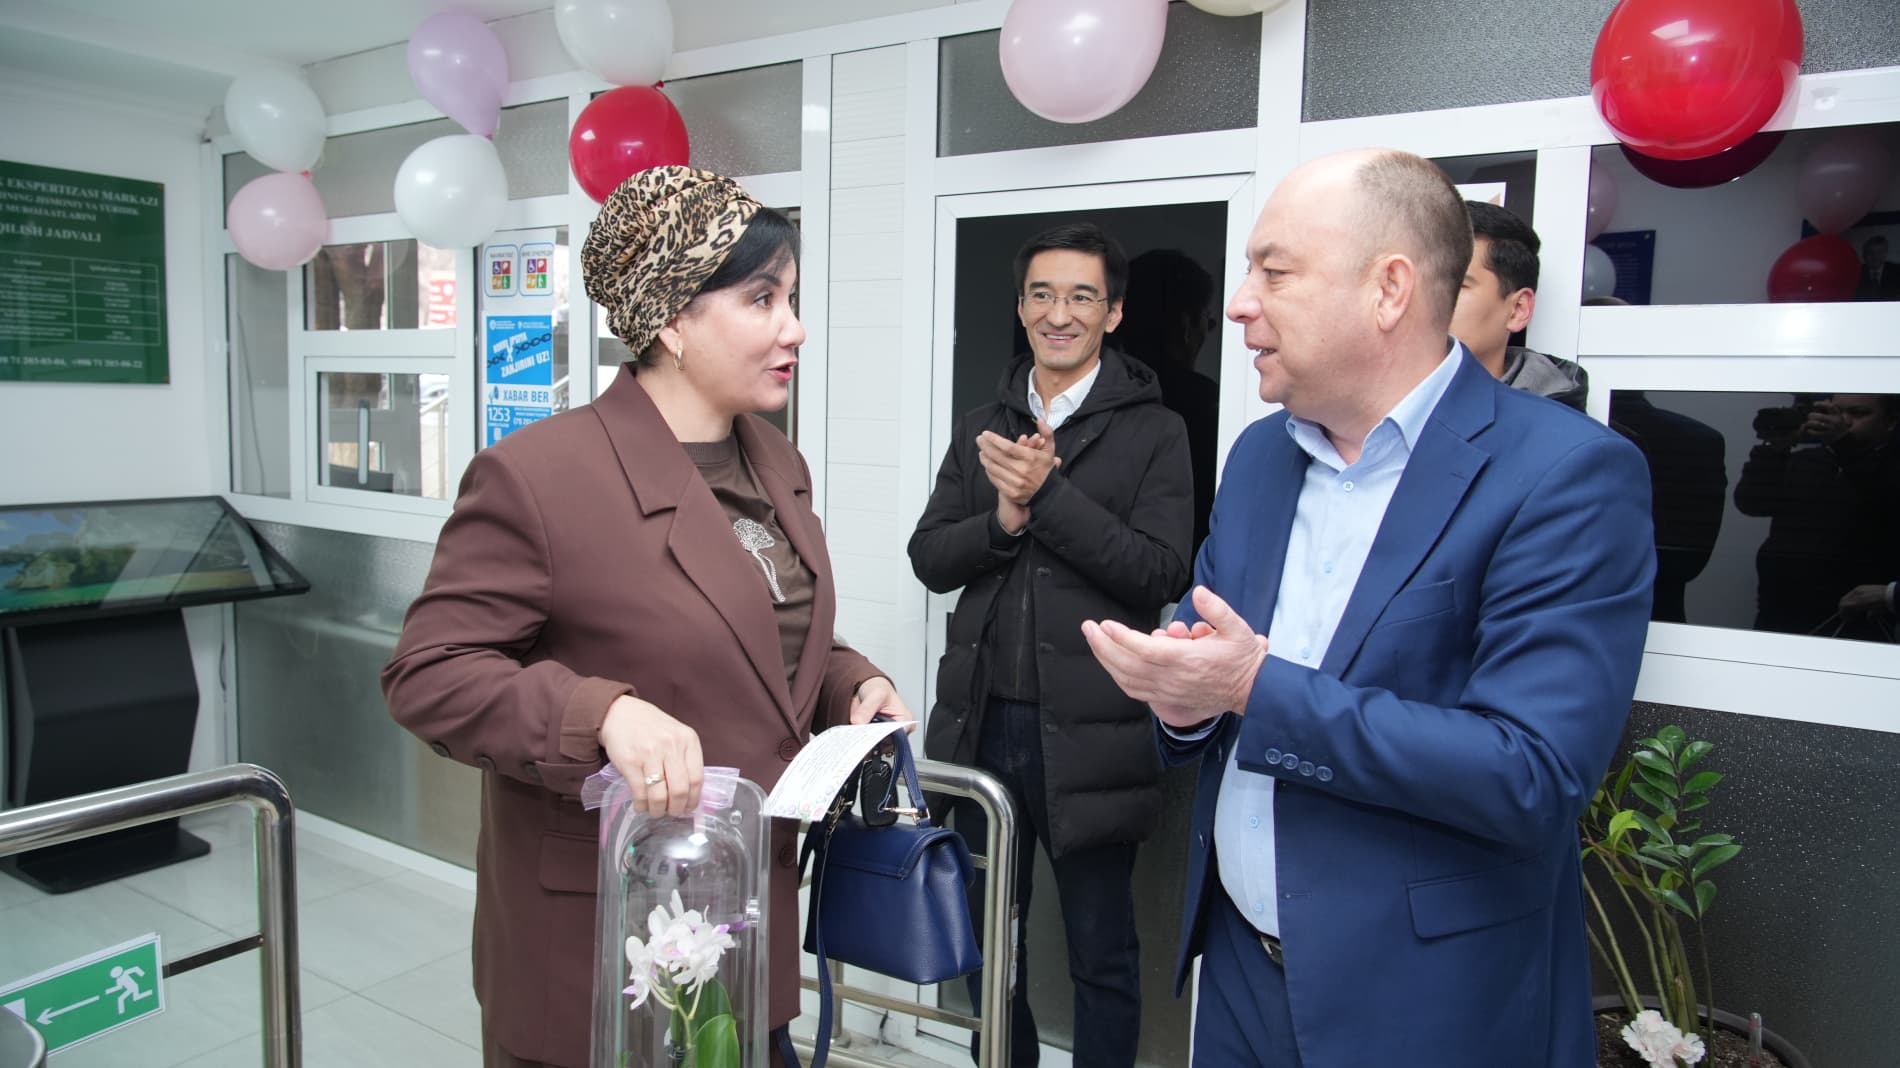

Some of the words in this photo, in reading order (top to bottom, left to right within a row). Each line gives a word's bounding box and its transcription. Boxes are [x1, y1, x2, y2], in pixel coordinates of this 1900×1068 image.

[7, 177, 99, 199] EKSPERTIZASI
[102, 191, 159, 207] MARKAZI
[45, 226, 102, 243] JADVALI
[503, 389, 529, 401] XABAR
[531, 391, 549, 403] BER
[487, 407, 511, 423] 1253
